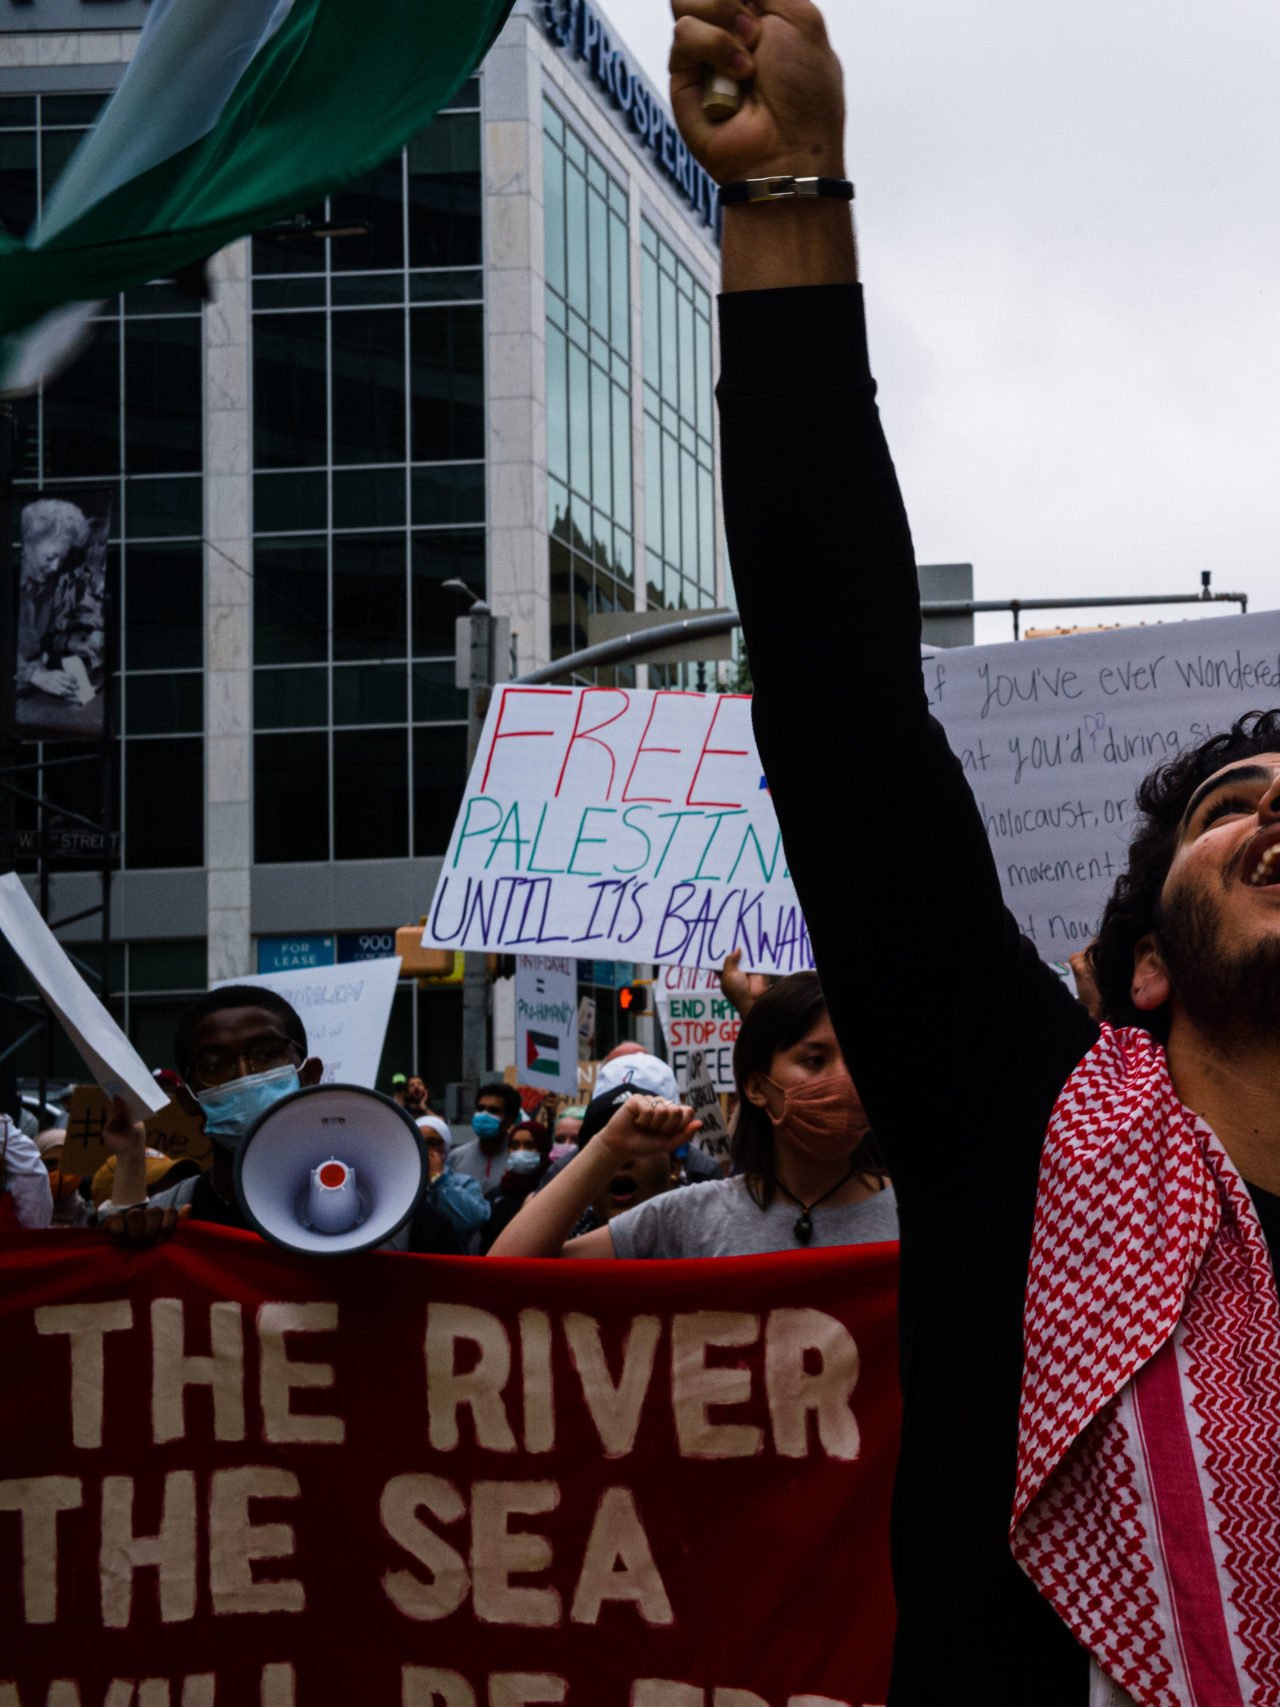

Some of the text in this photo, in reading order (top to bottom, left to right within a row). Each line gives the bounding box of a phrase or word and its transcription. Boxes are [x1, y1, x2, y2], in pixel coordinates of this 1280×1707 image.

[577, 2, 719, 228] PROSPERITY
[1099, 656, 1165, 695] ever
[481, 687, 752, 807] FREE
[1008, 728, 1083, 784] you'd
[1103, 726, 1180, 763] during
[60, 832, 118, 850] STRET
[454, 796, 799, 884] PALESTIN
[359, 935, 392, 951] 900
[431, 875, 817, 972] UNTIL IT'S BACKWAR
[274, 955, 317, 967] LEASE
[281, 943, 310, 953] FOR
[671, 999, 706, 1018] END
[671, 1021, 717, 1046] STOP
[34, 1298, 862, 1461] THE RIVER
[0, 1465, 674, 1628] THE SEA
